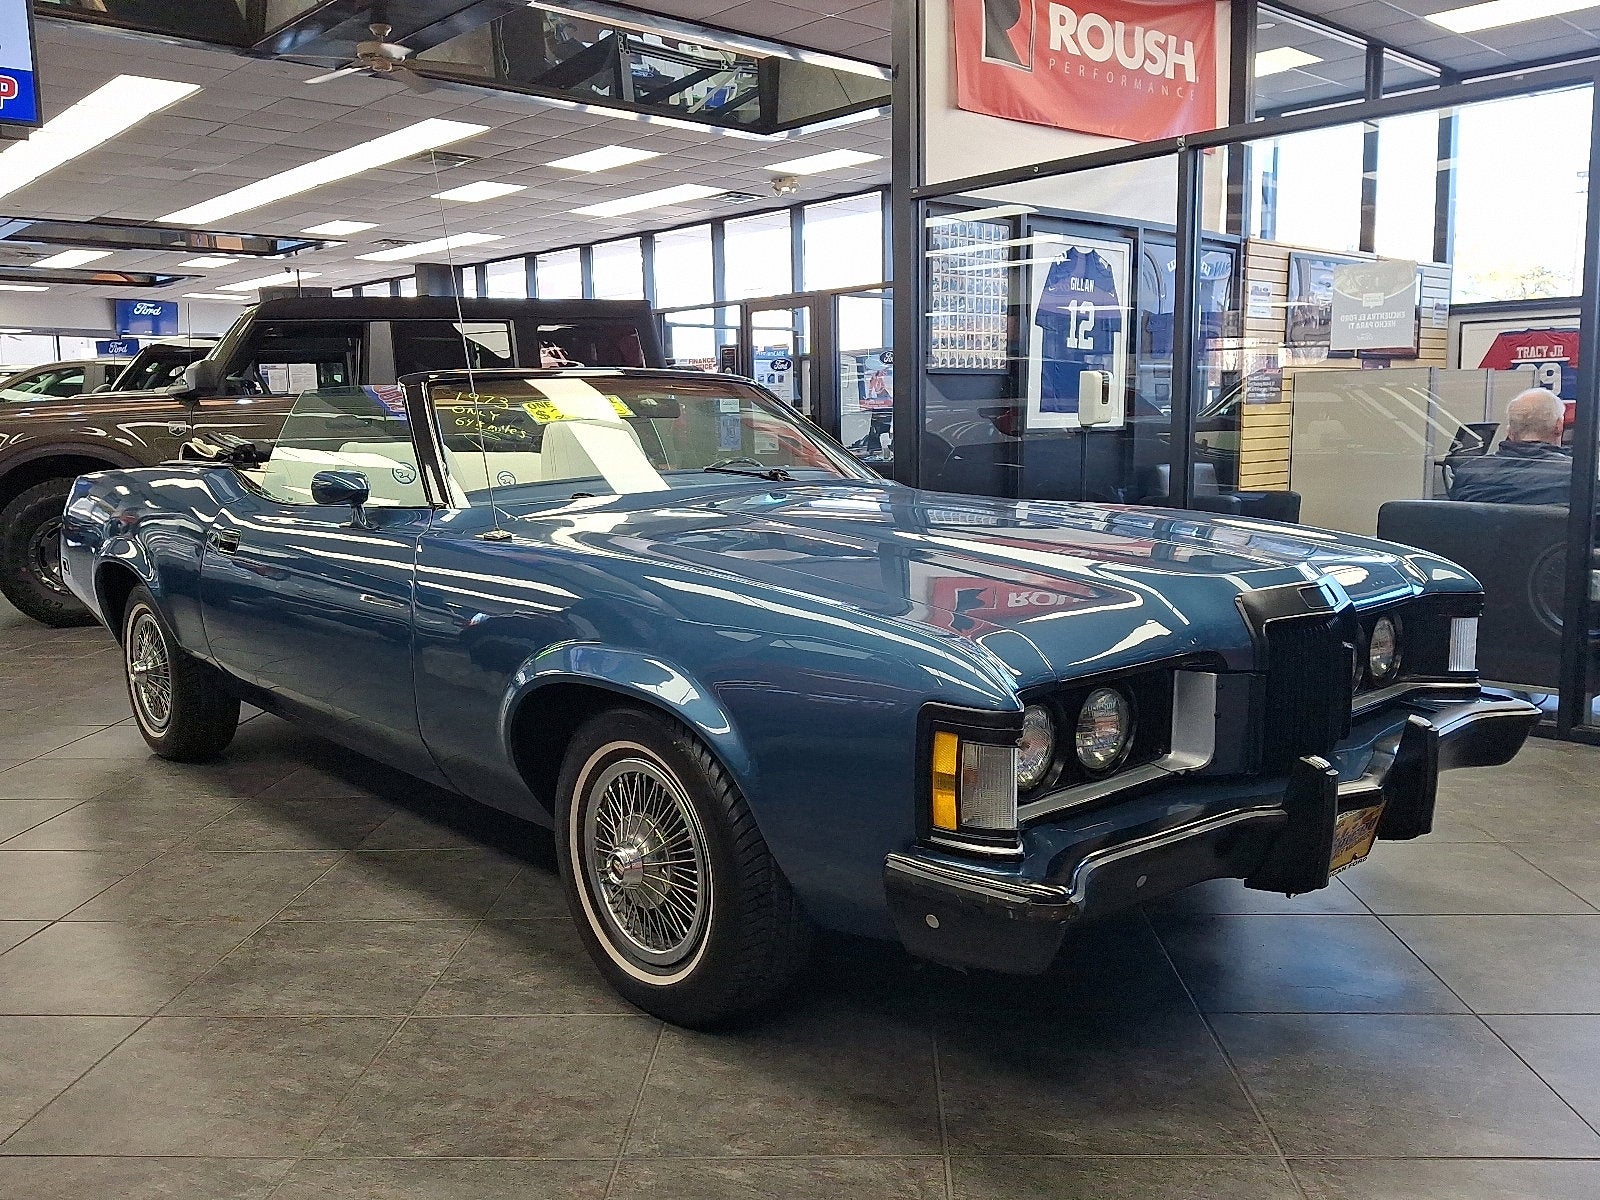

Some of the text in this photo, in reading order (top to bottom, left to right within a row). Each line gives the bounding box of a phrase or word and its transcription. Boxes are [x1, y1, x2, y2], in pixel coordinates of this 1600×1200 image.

[1049, 2, 1196, 83] ROUSH
[1049, 58, 1195, 101] PERFORMANCE
[1070, 276, 1095, 293] GILLAN
[133, 302, 162, 316] Ford
[1067, 299, 1095, 350] 12
[108, 341, 128, 354] Ford
[1516, 344, 1564, 359] TRACY JR
[688, 357, 715, 365] FINANCE
[773, 359, 789, 370] Ford
[456, 391, 509, 409] 1973
[1348, 856, 1368, 869] FORD
